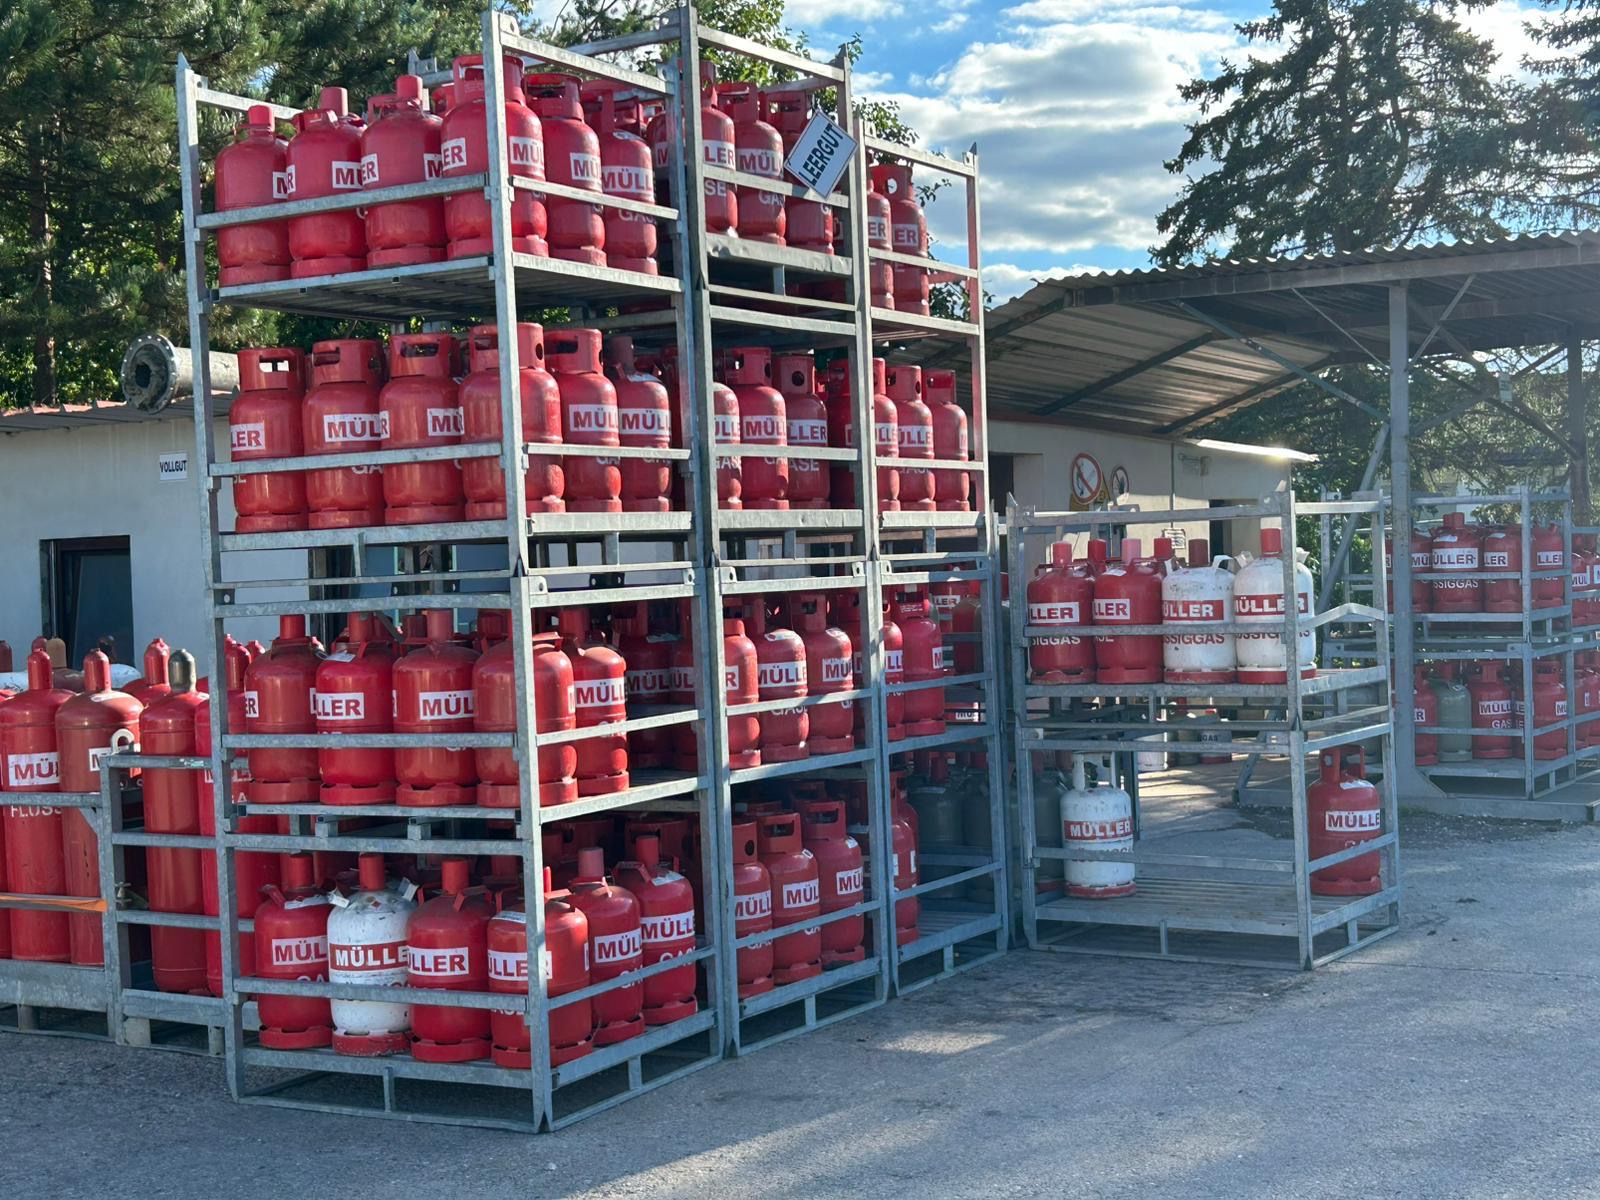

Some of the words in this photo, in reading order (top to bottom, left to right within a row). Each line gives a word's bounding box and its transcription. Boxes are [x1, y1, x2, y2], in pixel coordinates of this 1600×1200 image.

[799, 123, 843, 186] LEERGUT
[160, 460, 187, 473] VOLLGUT
[421, 693, 474, 716] MÜL
[1070, 820, 1131, 837] MÜLLER
